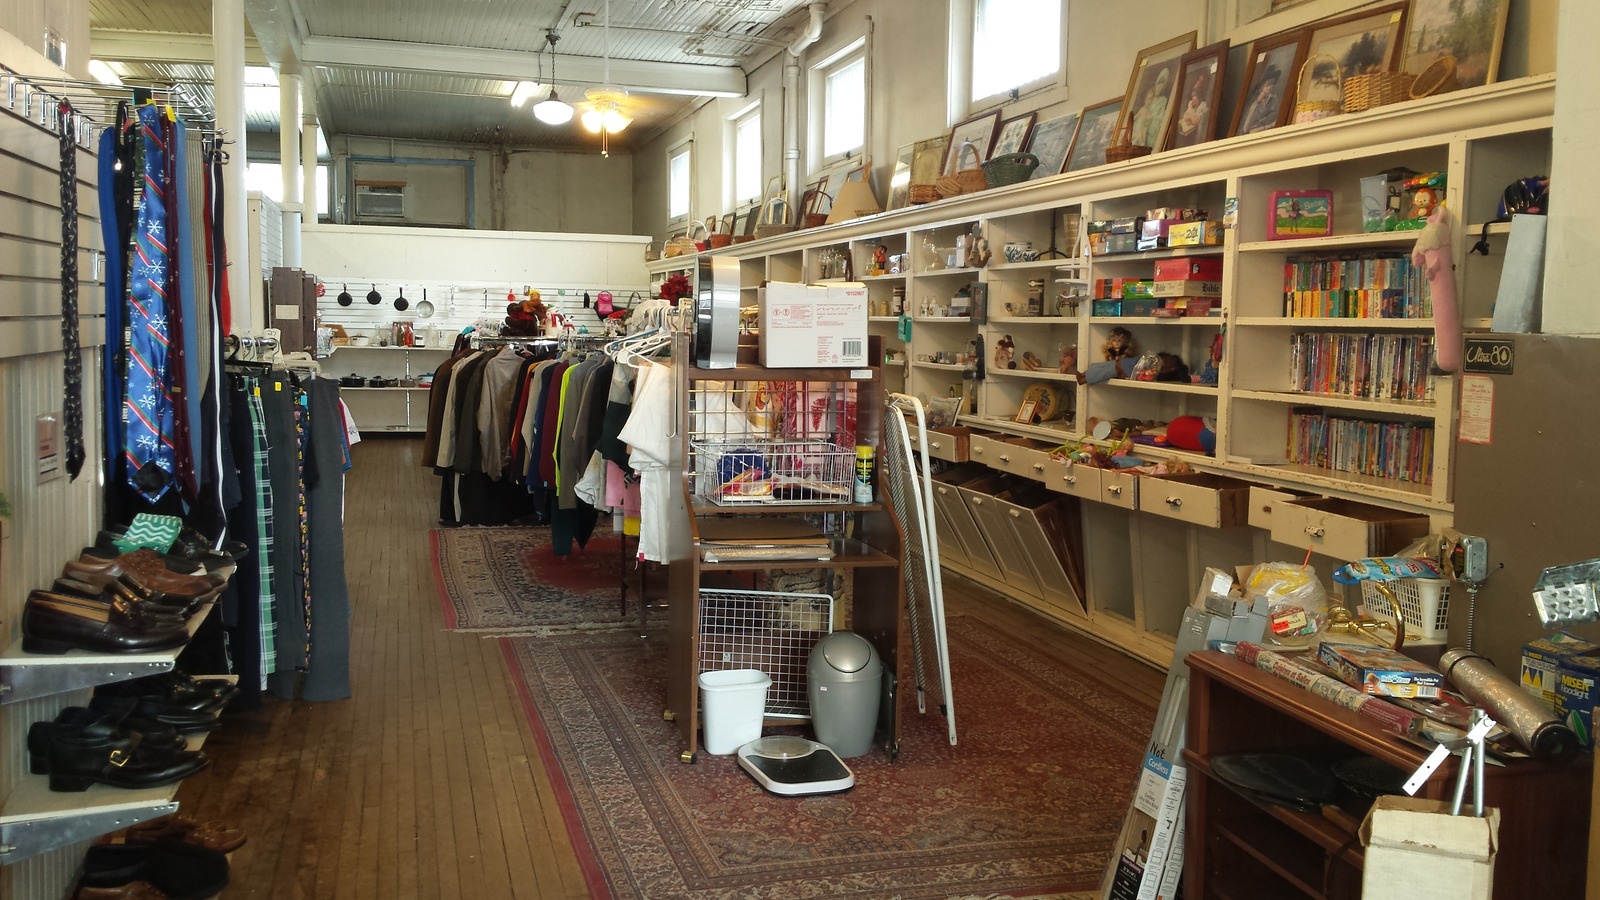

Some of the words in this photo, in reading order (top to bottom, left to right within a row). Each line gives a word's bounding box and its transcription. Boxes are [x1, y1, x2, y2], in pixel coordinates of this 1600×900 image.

[1304, 200, 1325, 210] Barbie
[1201, 282, 1220, 293] Bible
[1466, 346, 1491, 363] Ultra
[1490, 345, 1511, 366] 80
[1560, 684, 1590, 700] Floodlight
[1149, 741, 1166, 760] Not
[1148, 758, 1169, 775] Cordless
